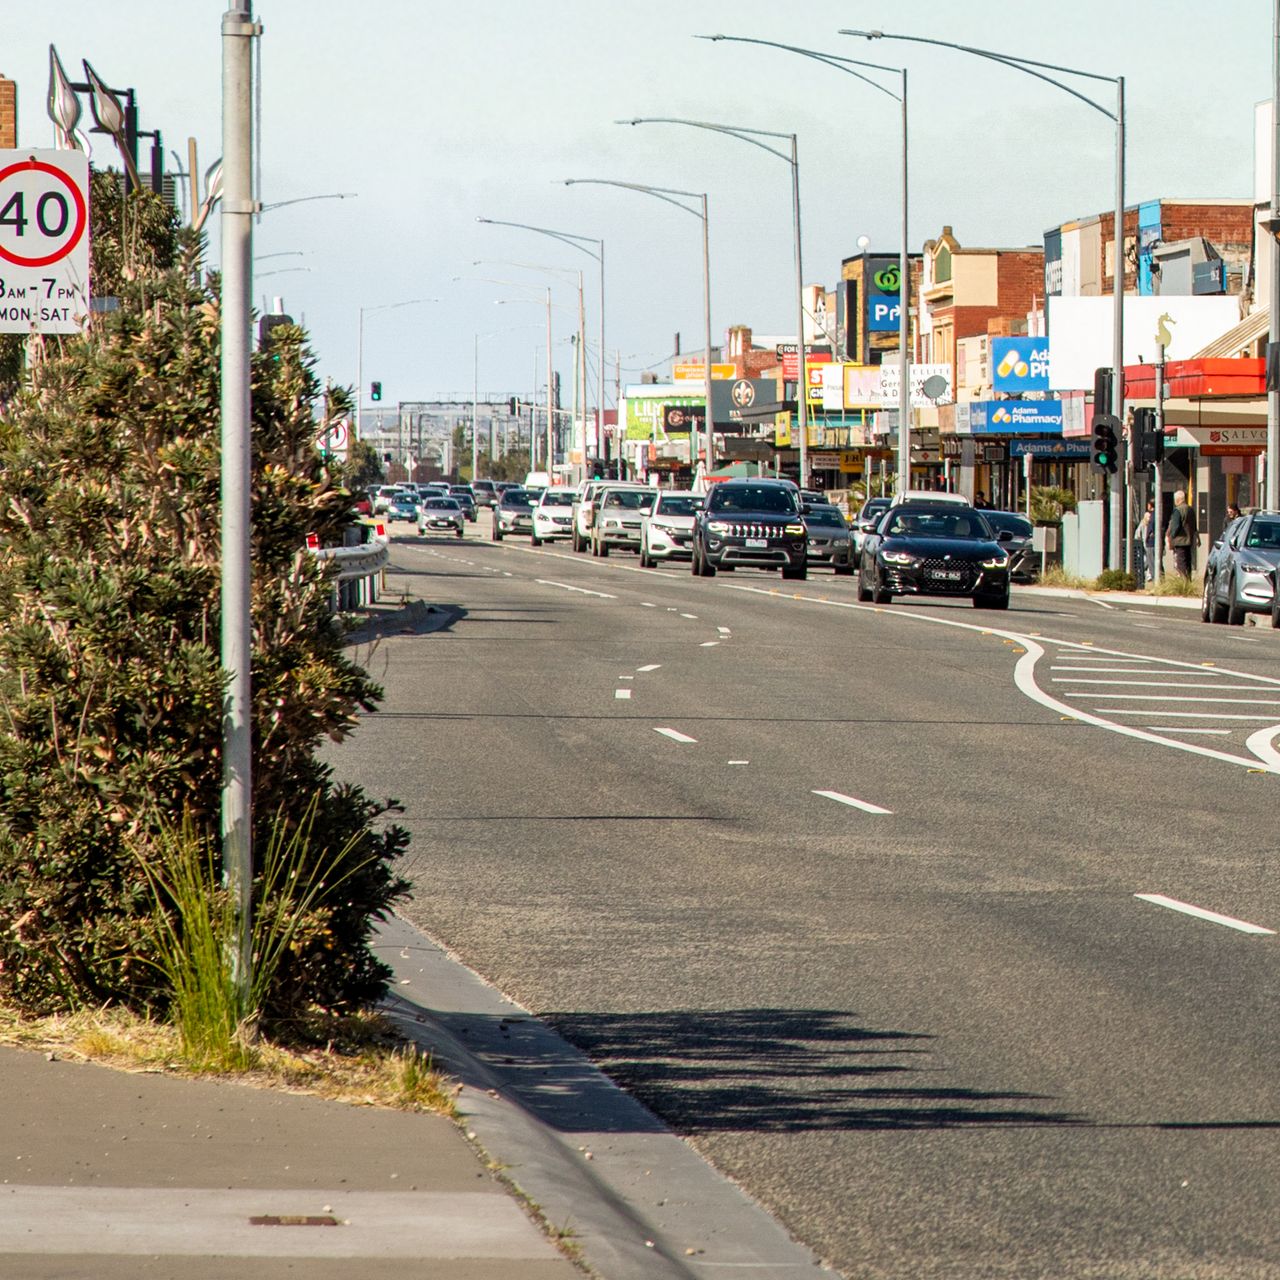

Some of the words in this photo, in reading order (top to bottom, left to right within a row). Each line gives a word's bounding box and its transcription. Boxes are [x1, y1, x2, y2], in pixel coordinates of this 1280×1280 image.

[0, 191, 69, 237] 40
[1012, 415, 1063, 425] Pharmacy
[1016, 443, 1052, 453] Adams
